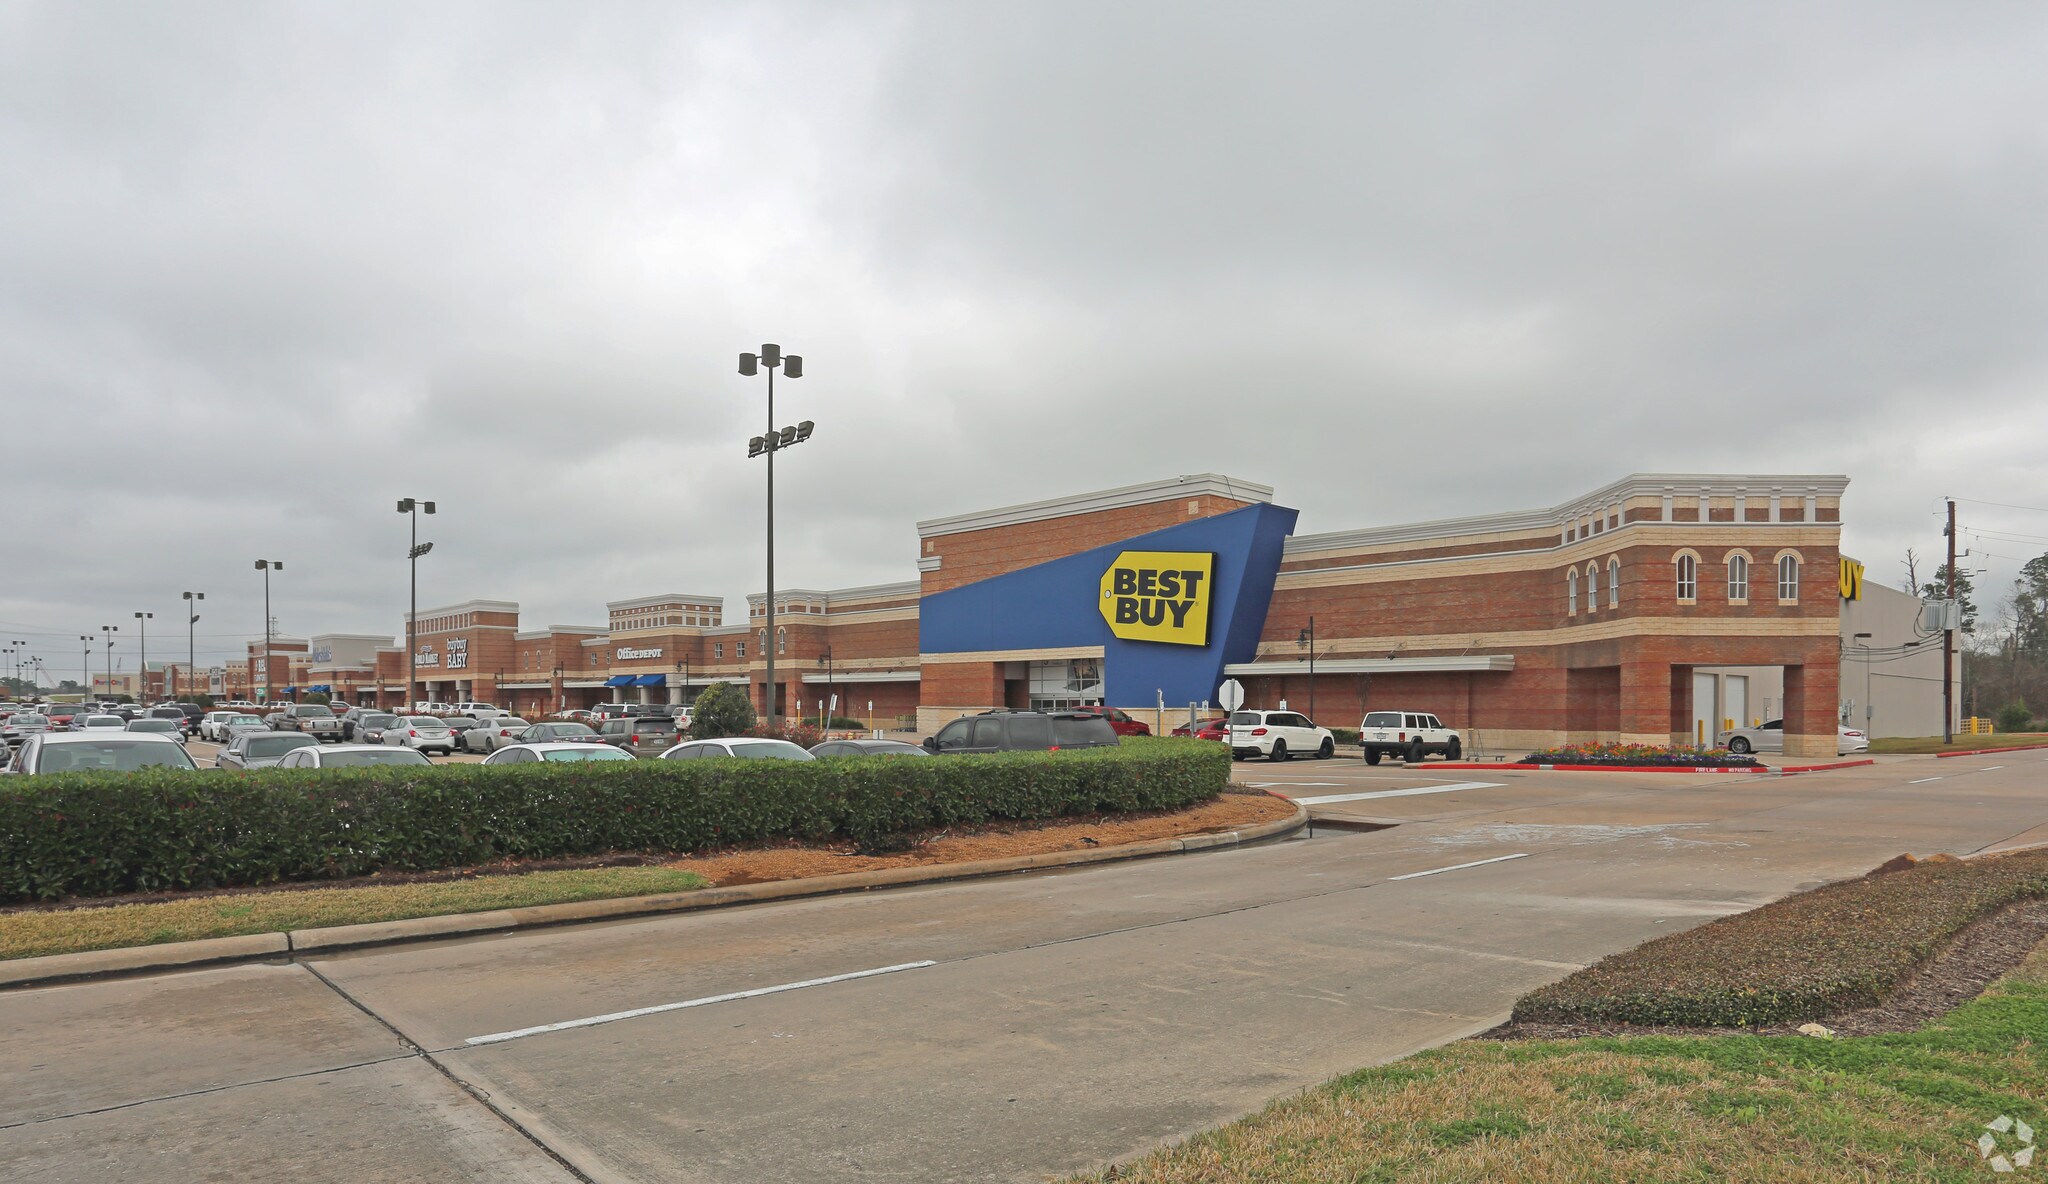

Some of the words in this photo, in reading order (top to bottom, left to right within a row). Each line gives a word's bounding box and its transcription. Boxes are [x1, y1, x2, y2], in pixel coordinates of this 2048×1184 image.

[1114, 568, 1203, 598] BEST
[1839, 557, 1864, 601] UY
[1116, 597, 1195, 628] BUY
[447, 653, 467, 669] BABY
